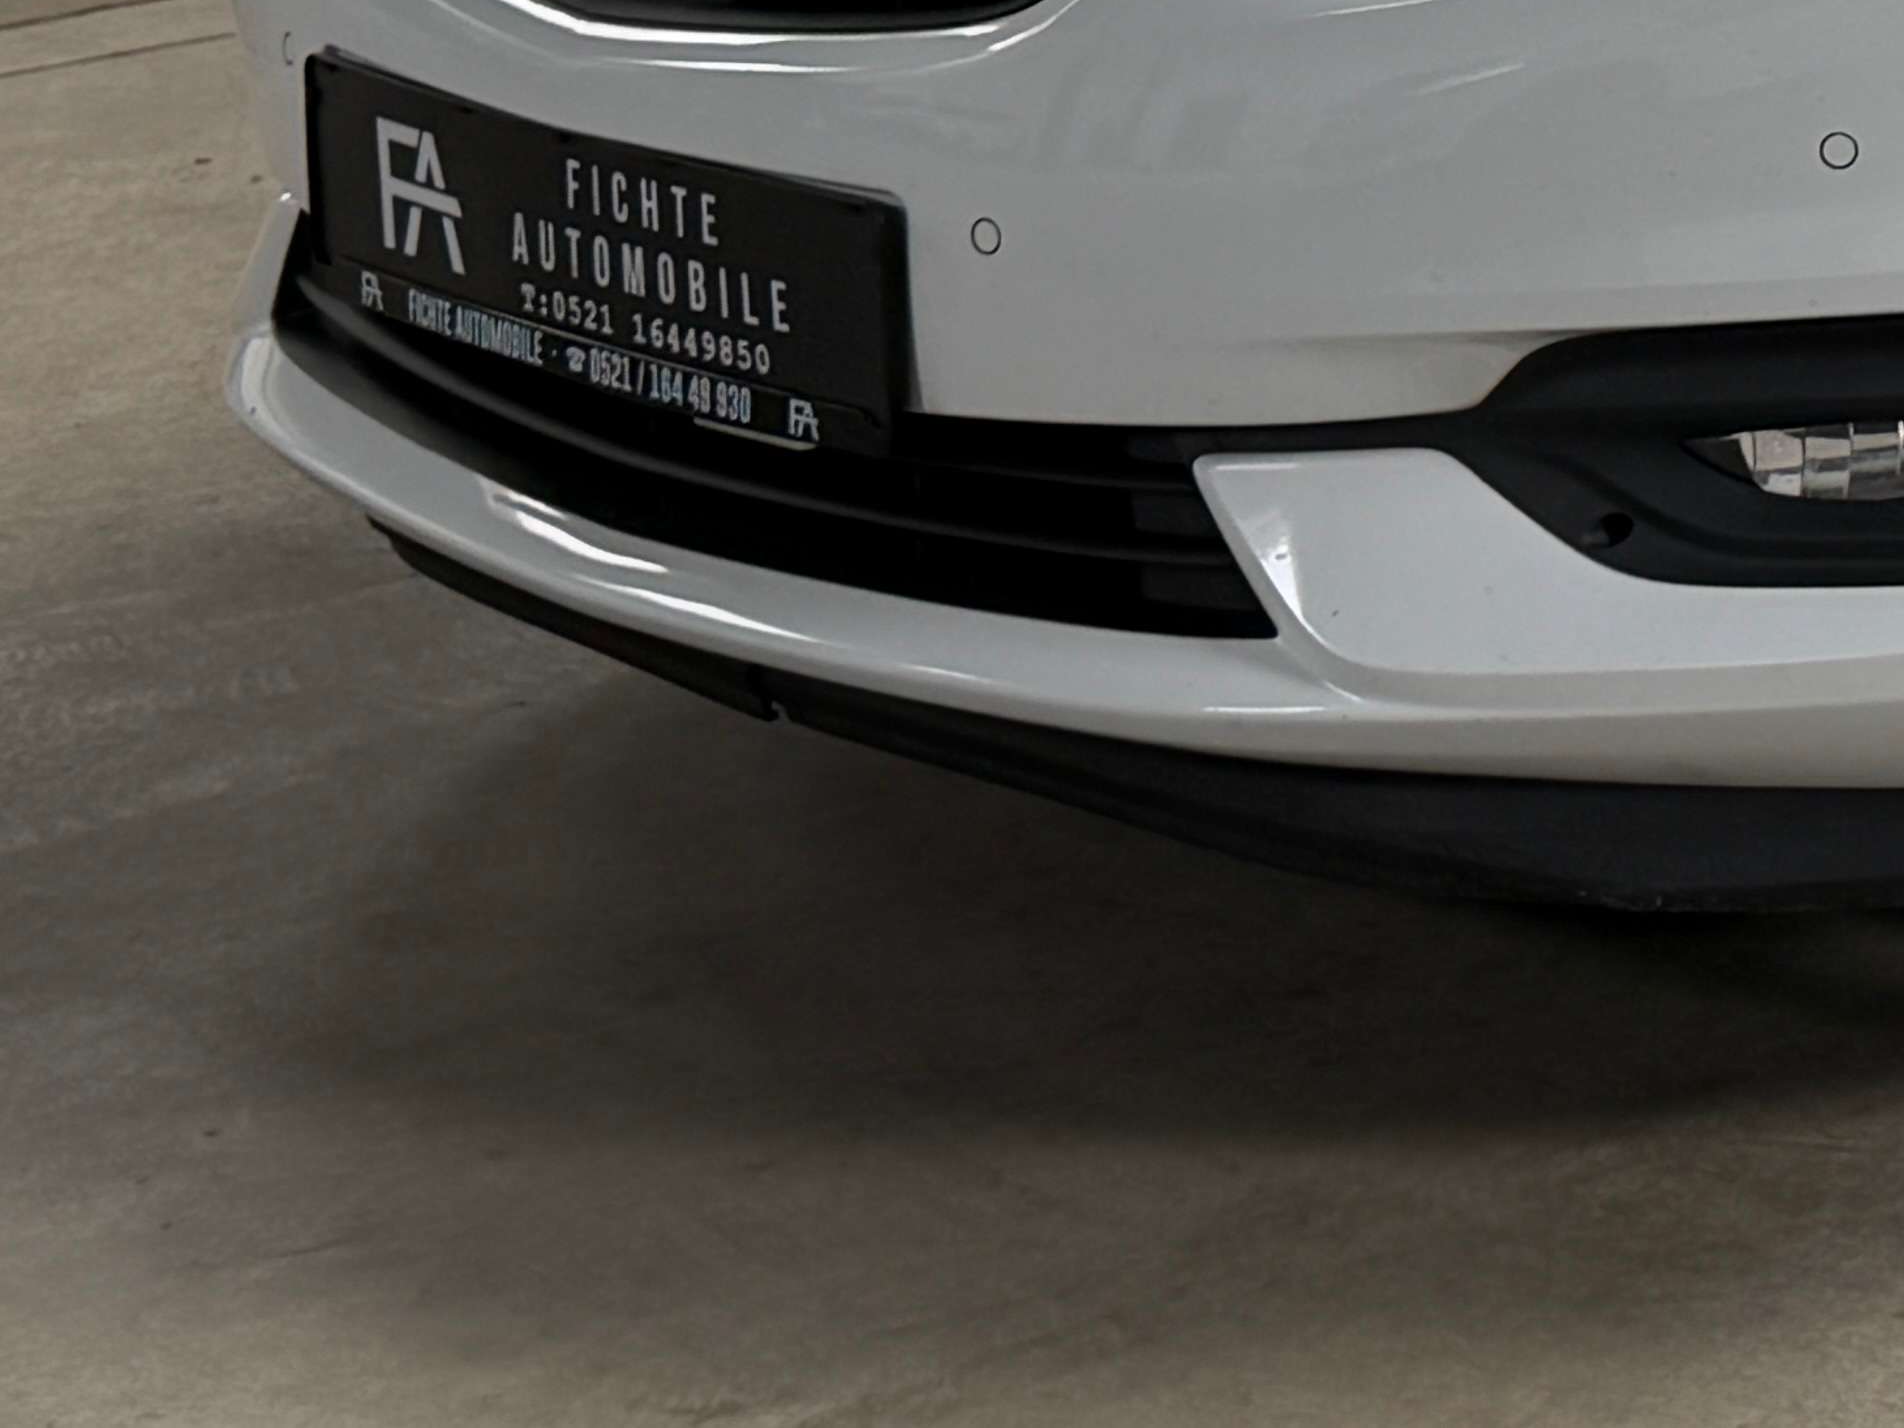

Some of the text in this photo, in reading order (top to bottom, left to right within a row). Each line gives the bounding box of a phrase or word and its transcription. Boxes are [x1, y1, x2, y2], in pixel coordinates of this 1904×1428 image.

[566, 158, 719, 246] FICHTE
[512, 212, 790, 333] AUTOMOBILE
[408, 288, 452, 336] FICHTE
[455, 305, 544, 367] AUTOMOBILE
[632, 313, 771, 375] 16449850
